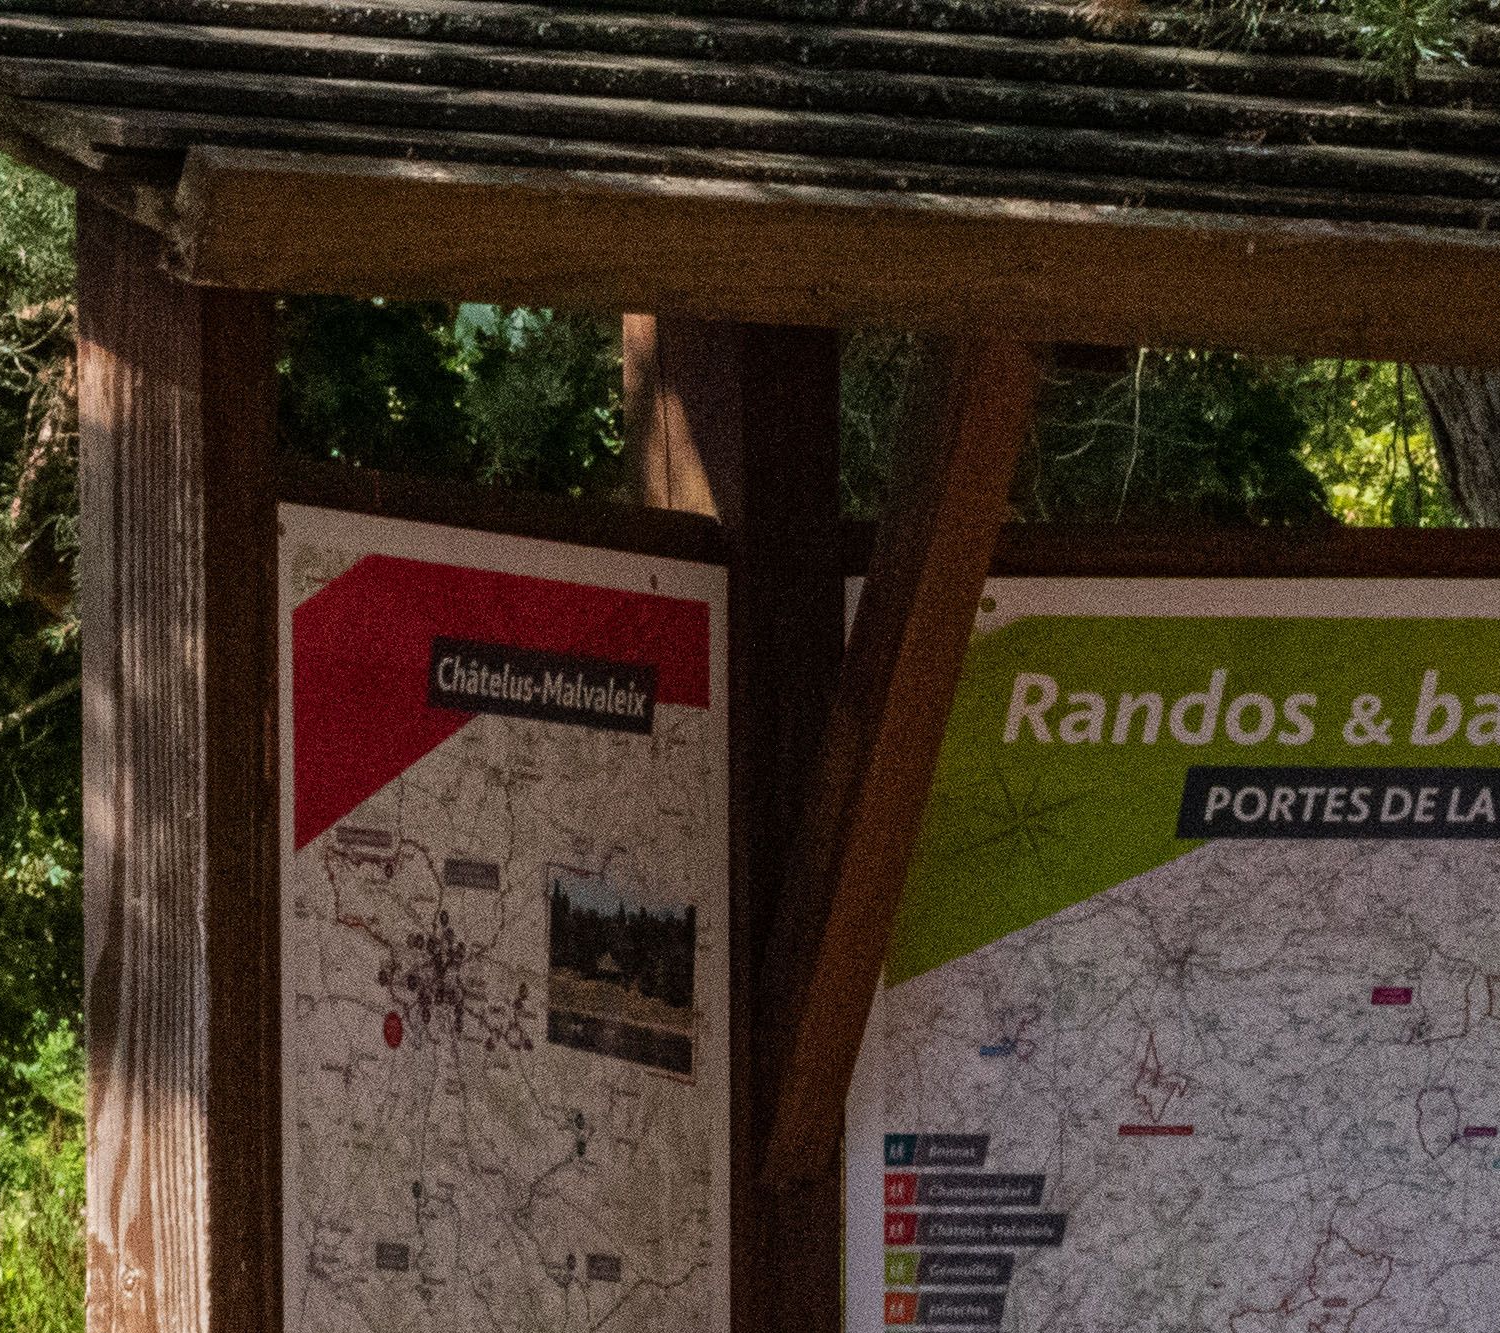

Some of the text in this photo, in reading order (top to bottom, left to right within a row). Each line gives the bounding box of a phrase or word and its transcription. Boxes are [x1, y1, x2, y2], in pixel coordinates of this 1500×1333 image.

[437, 655, 647, 717] Châtelus-Malvaleix
[1002, 668, 1316, 747] Randos
[1343, 690, 1393, 746] &
[1204, 785, 1372, 825] PORTES
[1380, 785, 1434, 825] DE
[1444, 785, 1498, 825] LA
